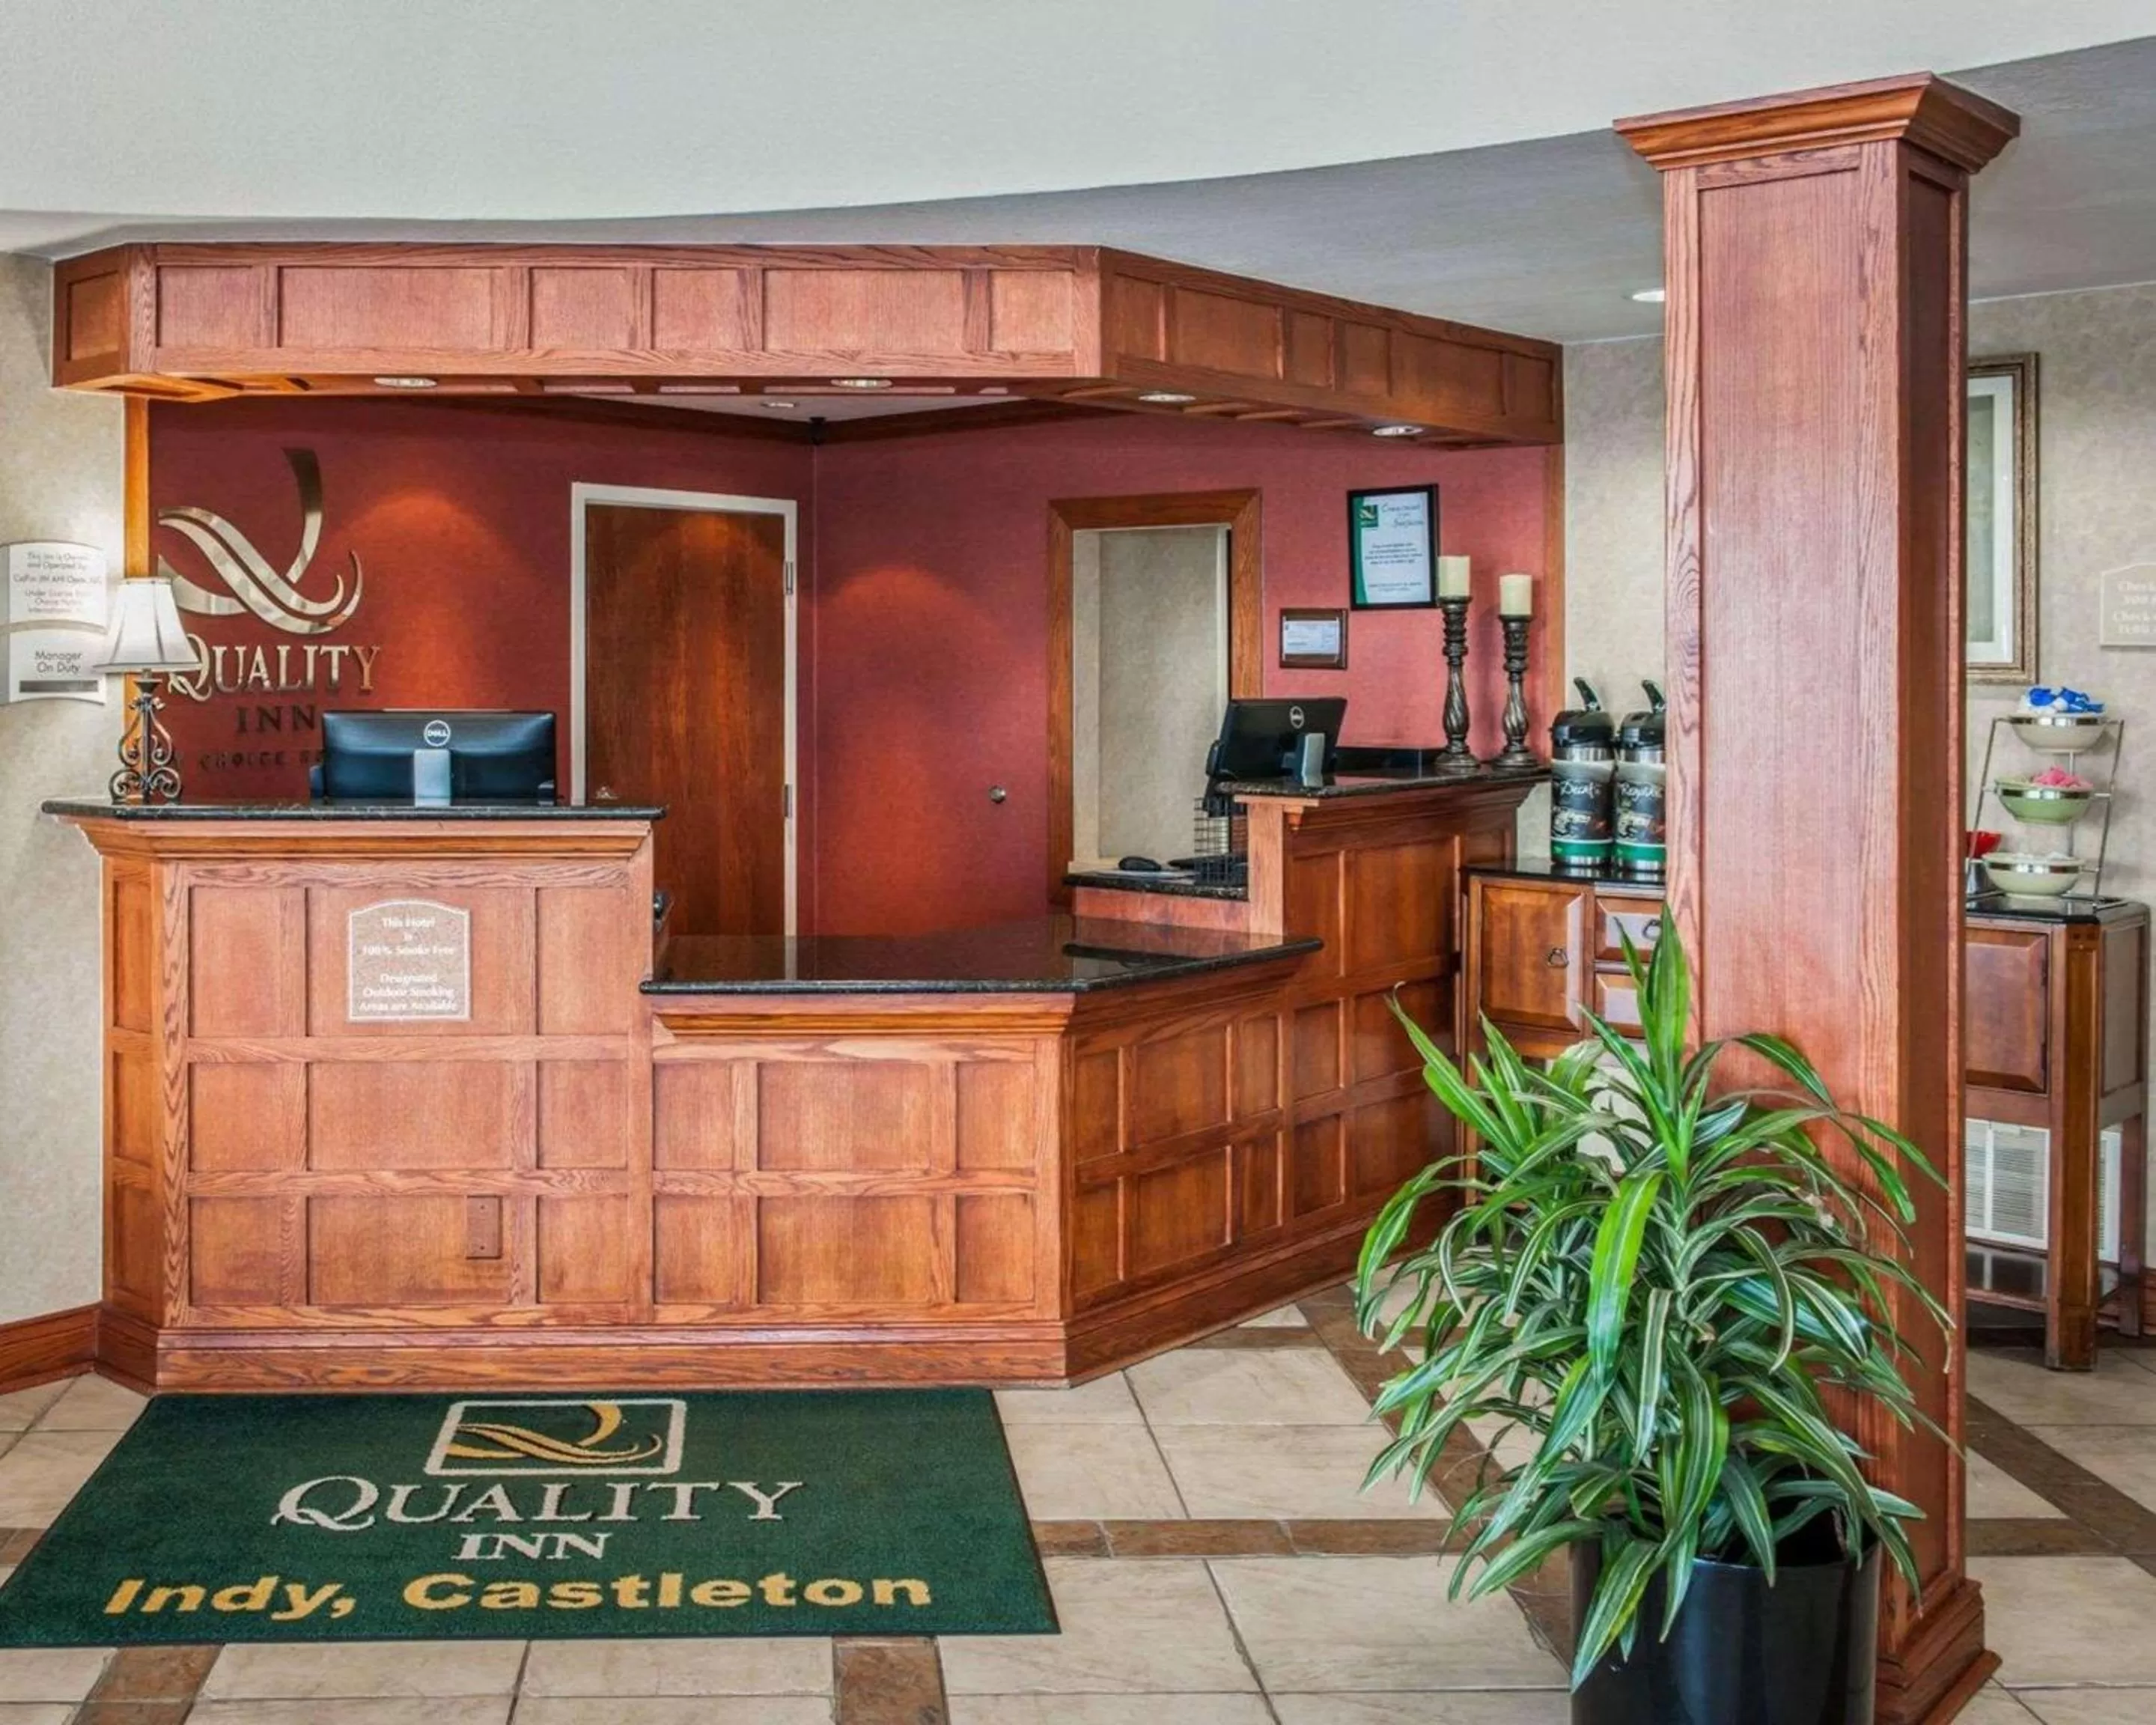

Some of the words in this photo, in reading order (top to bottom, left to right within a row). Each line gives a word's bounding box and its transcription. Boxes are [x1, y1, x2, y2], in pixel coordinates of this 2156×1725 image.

[34, 651, 82, 664] Manager
[37, 662, 53, 673] On
[57, 662, 81, 674] Duty
[236, 704, 317, 734] INN
[382, 917, 403, 928] This
[405, 916, 436, 928] Hotel
[270, 1476, 803, 1531] QUALITY
[451, 1533, 612, 1560] INN
[103, 1575, 356, 1621] Indy,
[402, 1572, 932, 1609] Castleton
